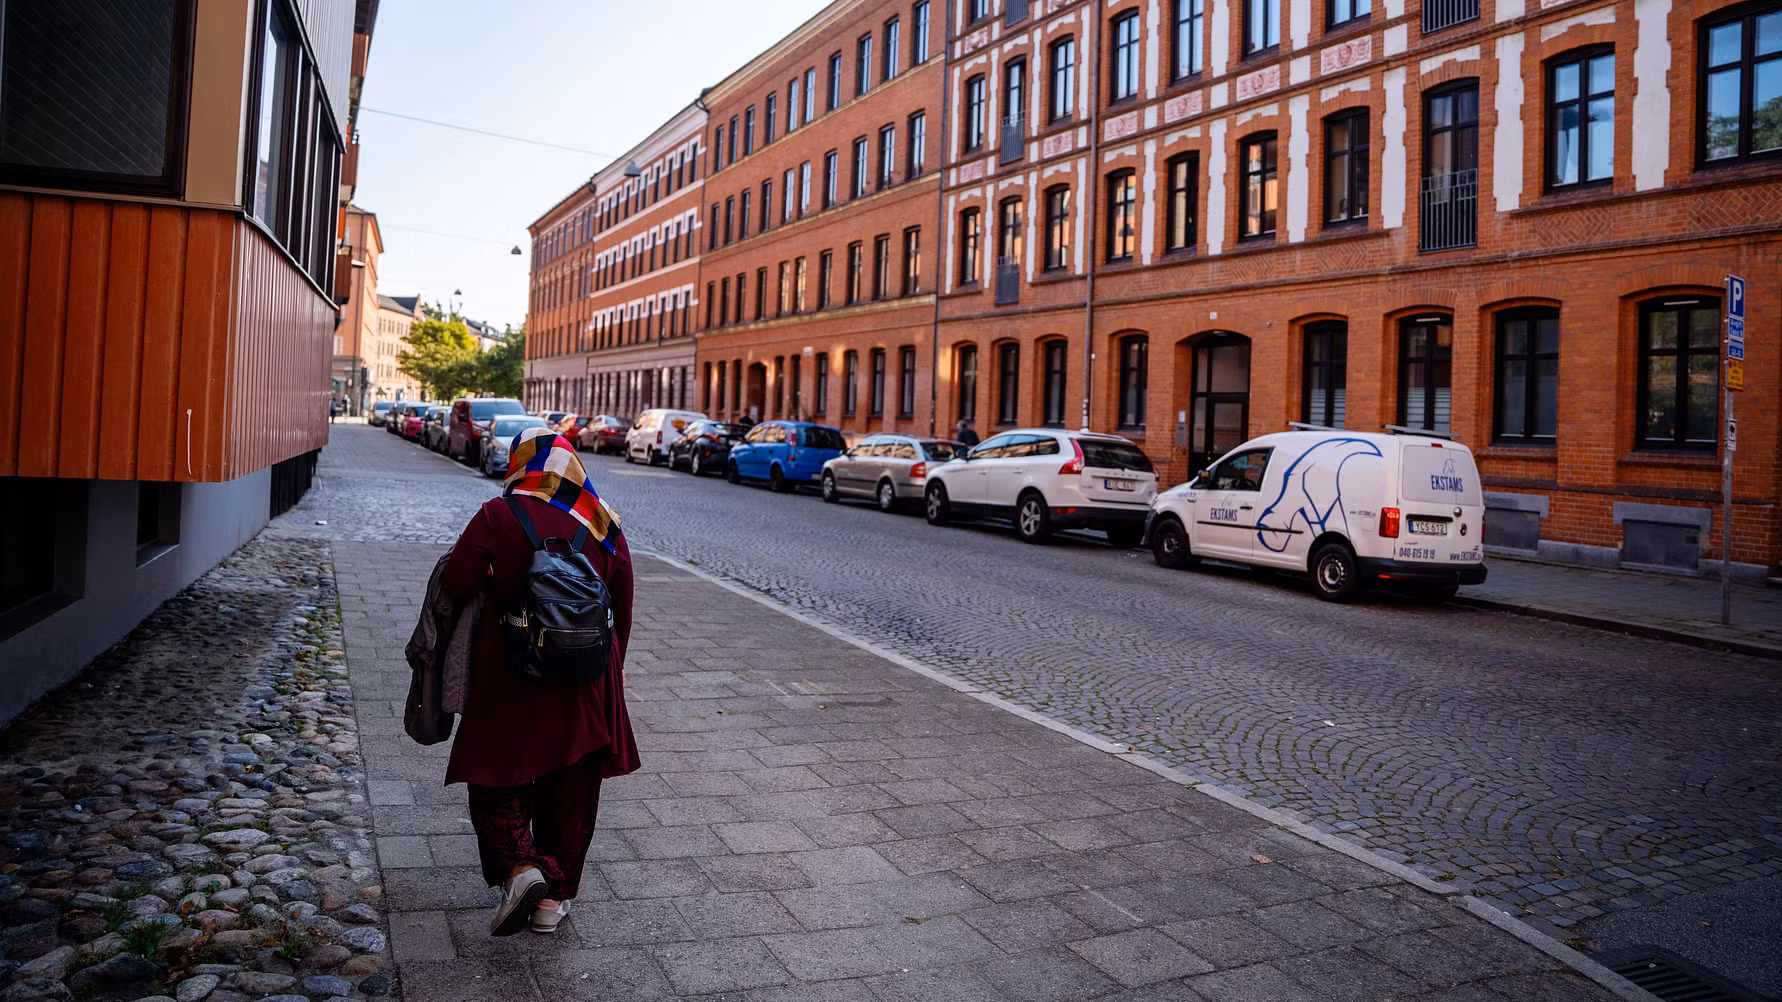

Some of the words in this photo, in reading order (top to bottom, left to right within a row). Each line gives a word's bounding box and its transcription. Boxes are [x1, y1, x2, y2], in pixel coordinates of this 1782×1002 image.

[1733, 279, 1742, 313] P
[1431, 475, 1463, 492] EKSTAMS
[1210, 507, 1238, 521] EKSTAMS
[1415, 522, 1430, 531] YCS
[1431, 522, 1444, 533] 612
[1399, 547, 1422, 558] 040-615
[1423, 548, 1429, 559] 19
